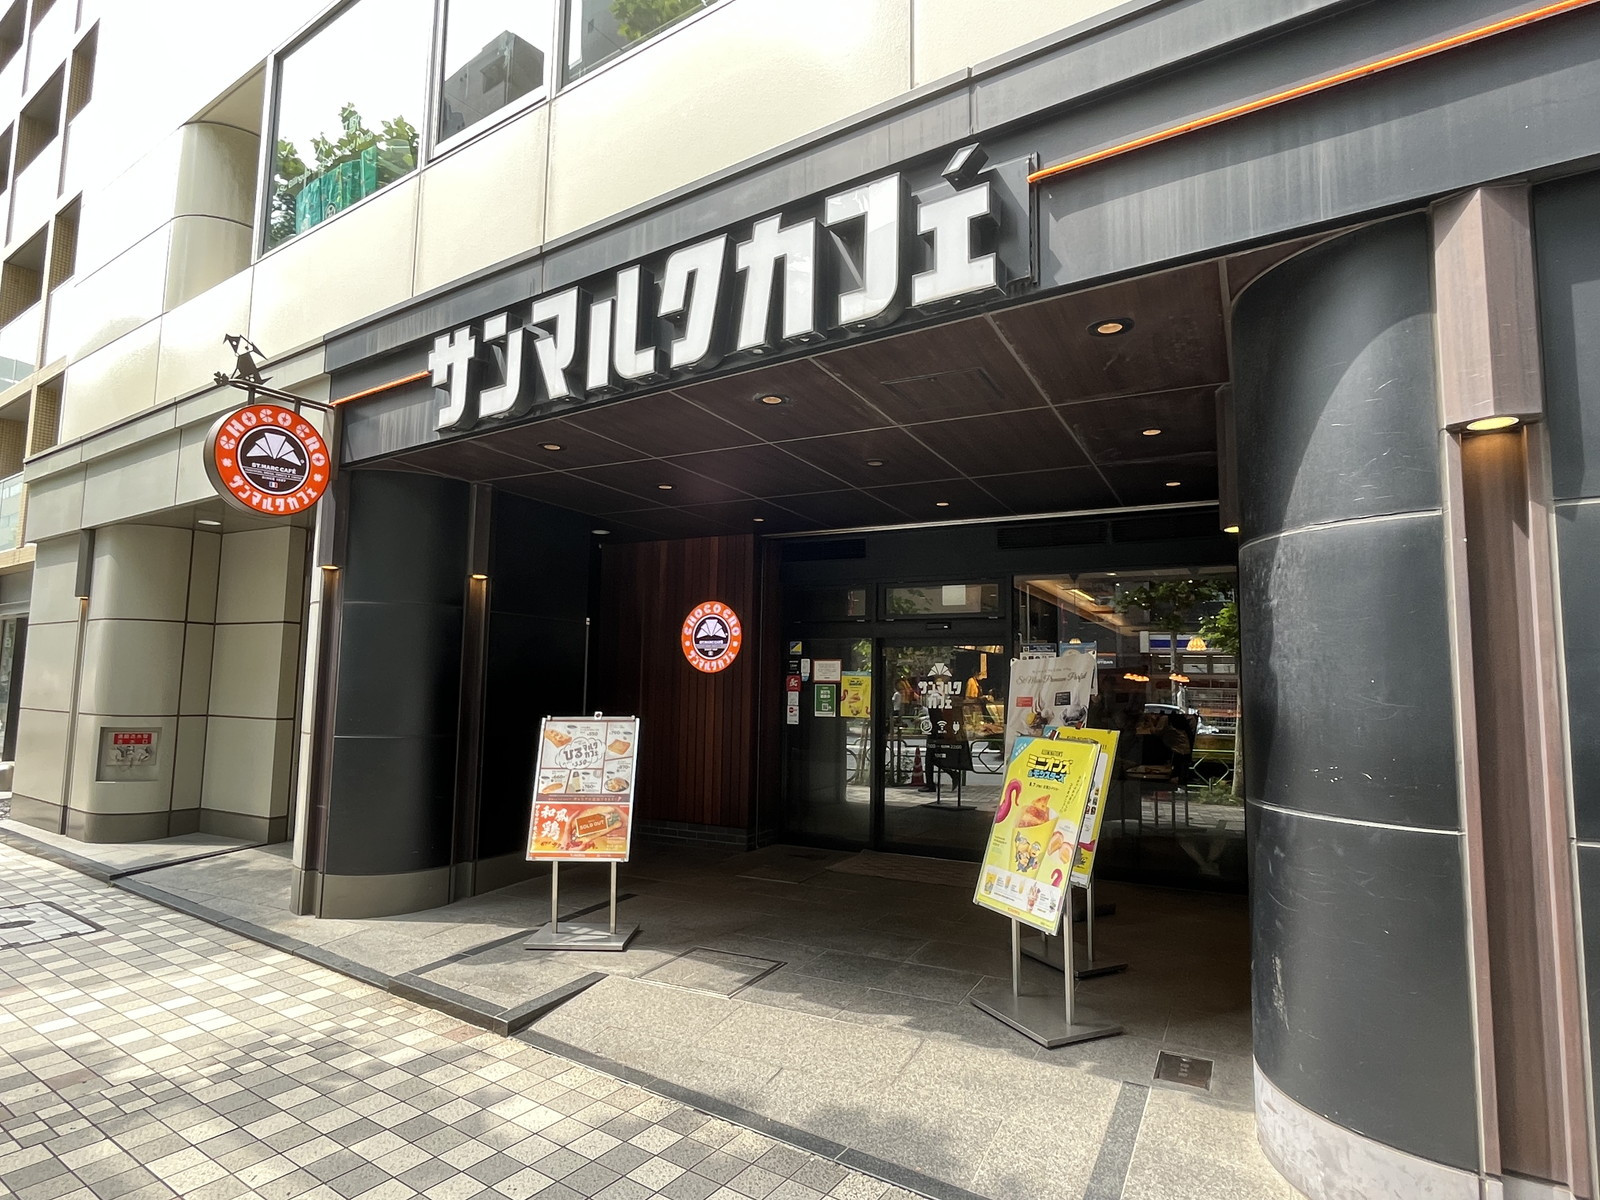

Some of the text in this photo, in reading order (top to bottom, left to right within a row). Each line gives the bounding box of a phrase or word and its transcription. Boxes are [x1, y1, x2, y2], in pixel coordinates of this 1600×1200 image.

[428, 143, 998, 432] サンマルクカフェ
[220, 408, 292, 450] CHOCO
[229, 475, 317, 512] サンマルクカフェ
[684, 604, 721, 636] CHOCO
[918, 681, 962, 695] サンマルク
[927, 696, 952, 709] カフェ
[1027, 754, 1073, 775] ミニオンズ
[541, 805, 569, 822] 和風
[593, 820, 605, 828] OUT
